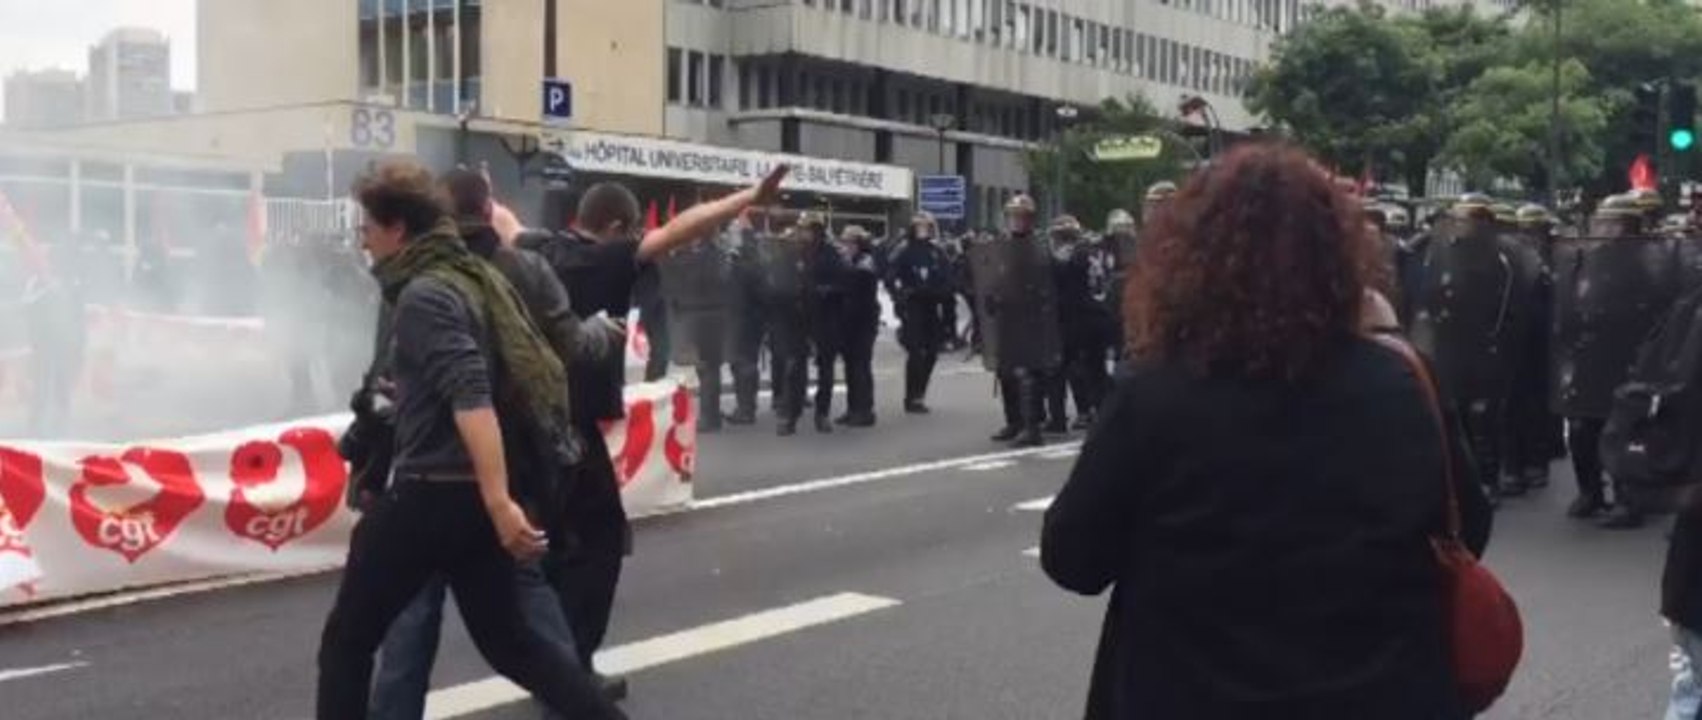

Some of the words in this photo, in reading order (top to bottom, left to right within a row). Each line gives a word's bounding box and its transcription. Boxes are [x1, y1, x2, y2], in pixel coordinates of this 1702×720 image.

[550, 87, 564, 111] P
[351, 108, 394, 148] 83
[584, 139, 646, 168] HÔPITAL
[649, 149, 751, 178] UNIVERSITAIRE
[99, 511, 159, 550] cgt
[246, 507, 307, 541] cgt
